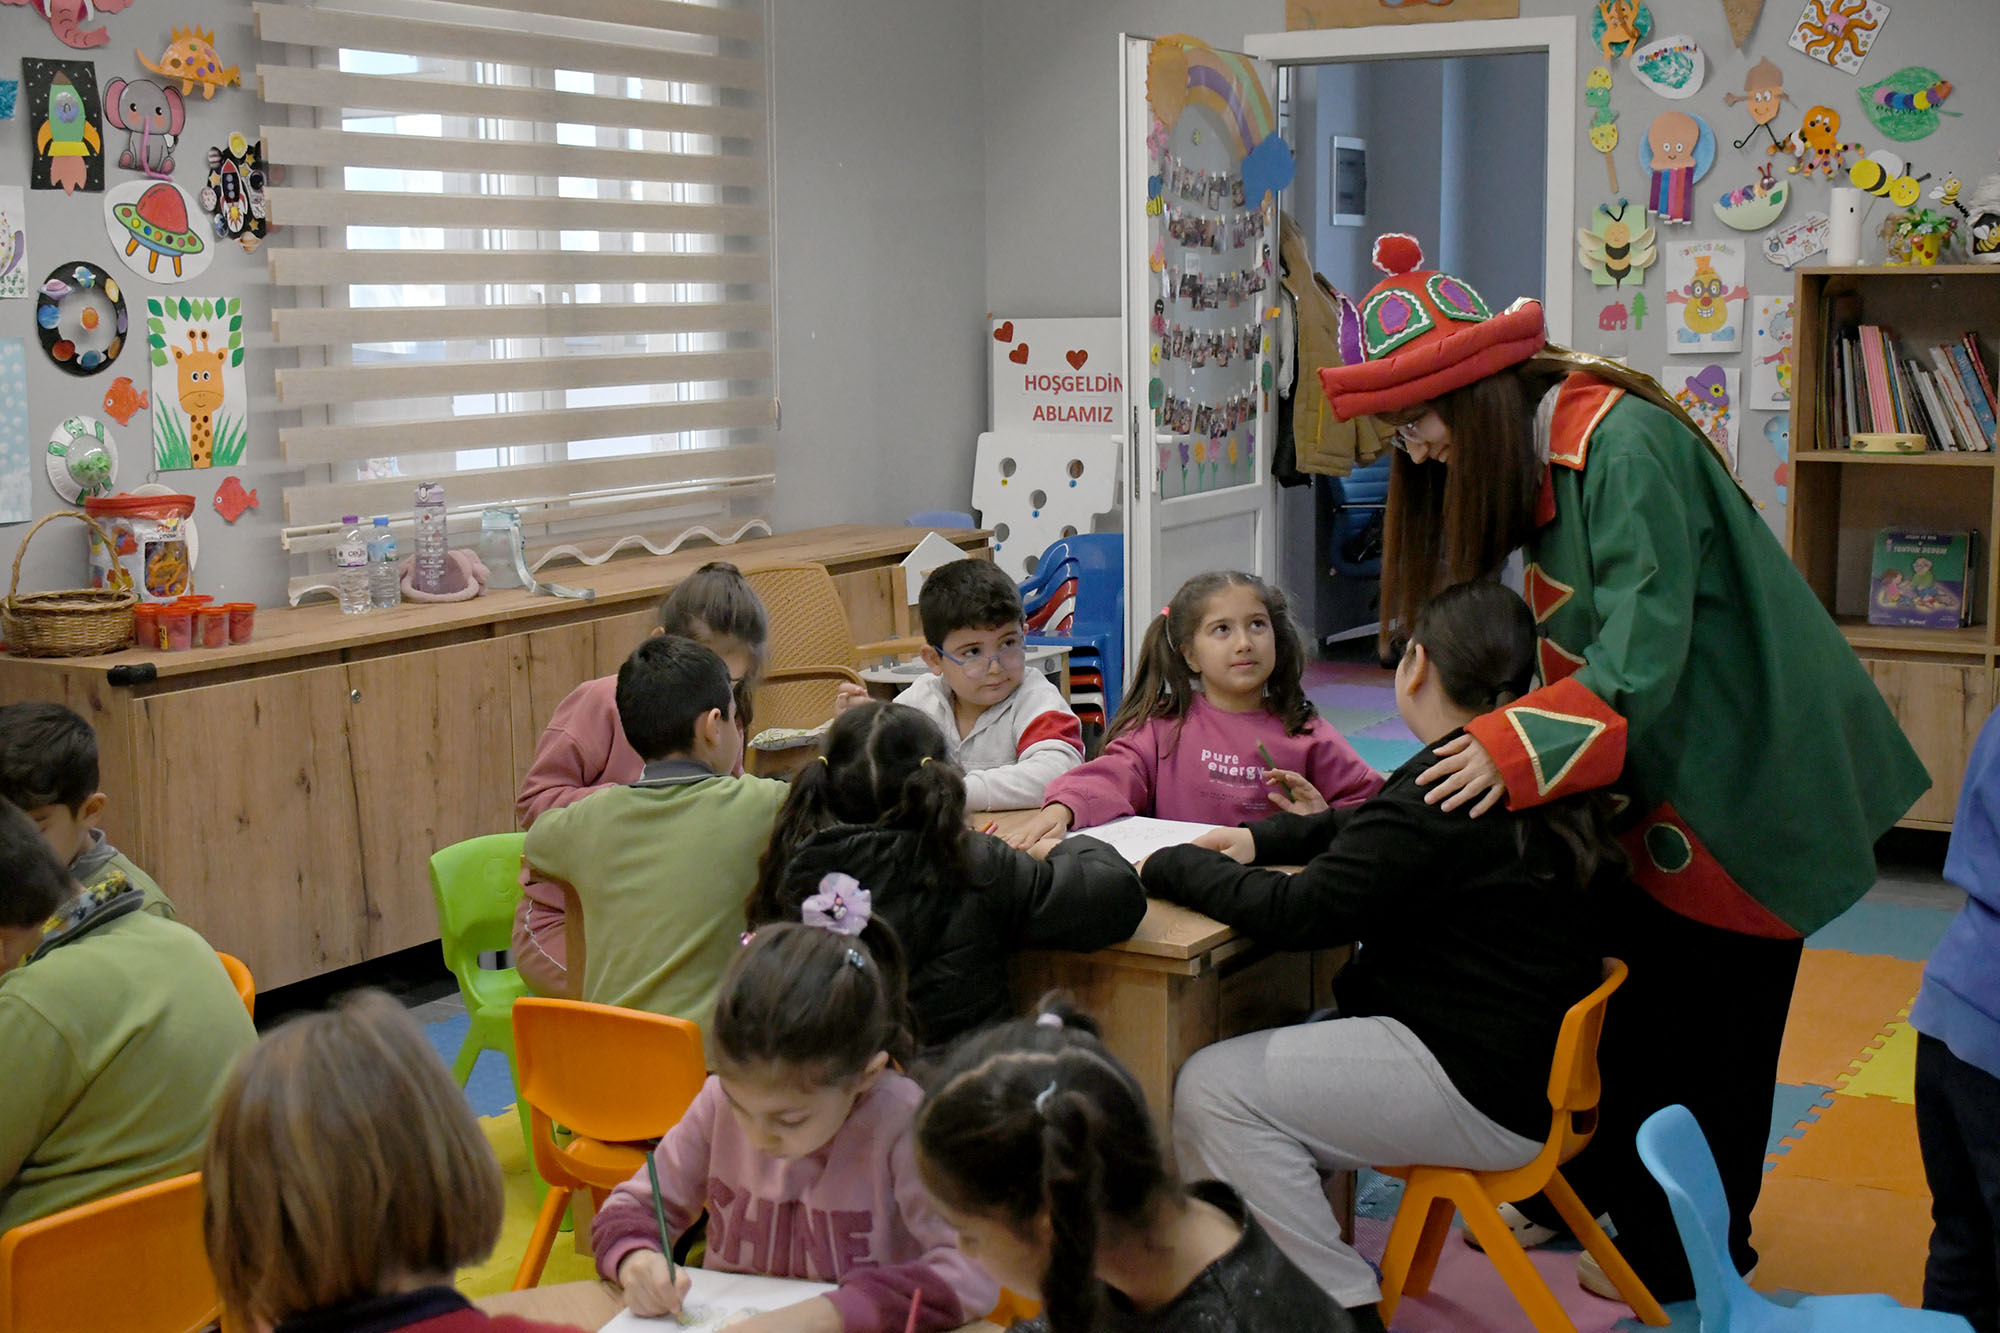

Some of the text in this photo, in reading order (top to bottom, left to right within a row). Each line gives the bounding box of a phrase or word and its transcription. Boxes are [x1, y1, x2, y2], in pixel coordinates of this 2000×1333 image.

[1024, 373, 1123, 395] HOŞGELDİN
[1032, 405, 1113, 423] ABLAMIZ
[1201, 749, 1239, 765] pure
[1208, 762, 1265, 780] energy
[706, 1177, 878, 1282] SHINE
